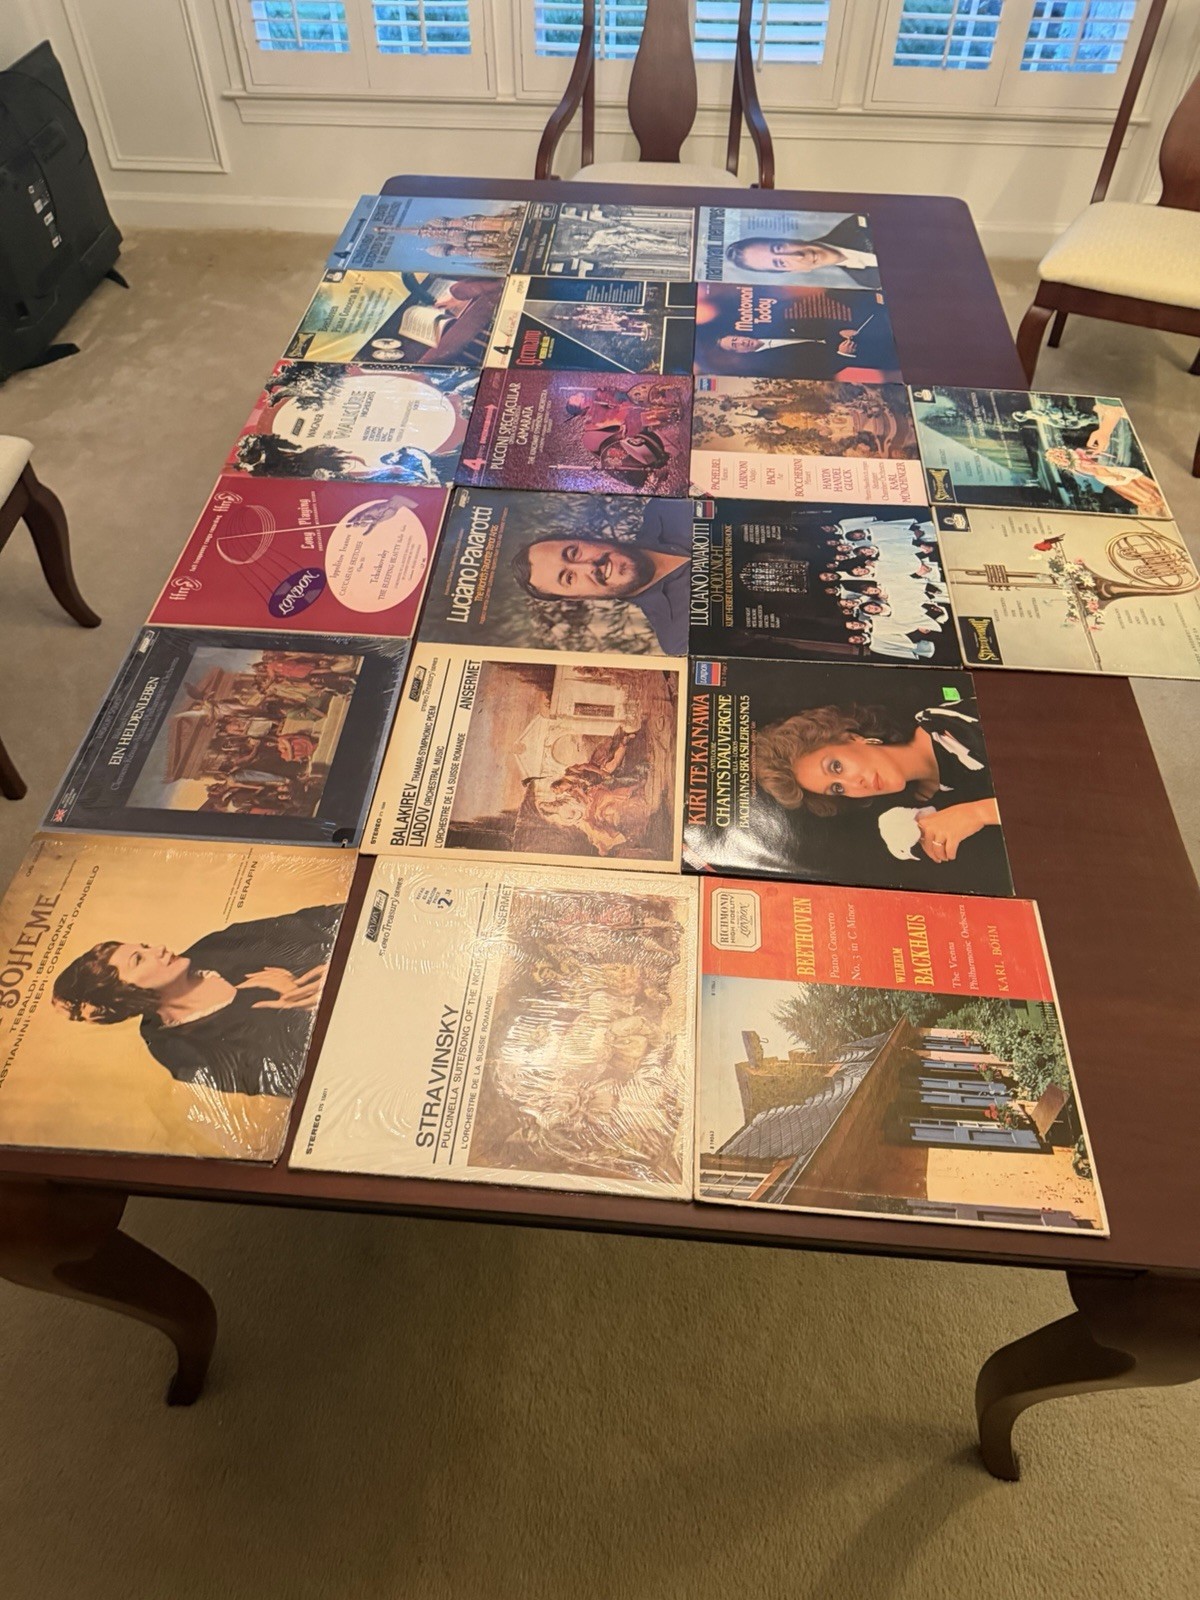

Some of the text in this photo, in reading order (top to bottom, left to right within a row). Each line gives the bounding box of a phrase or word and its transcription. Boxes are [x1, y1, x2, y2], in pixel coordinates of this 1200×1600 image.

[733, 286, 755, 331] Mantovani
[753, 297, 779, 324] Today
[491, 345, 512, 354] 4
[328, 390, 367, 439] WALKÜRE
[489, 382, 521, 469] PUCCINI SPECTACULAR
[515, 405, 534, 444] CAMARATA
[461, 456, 485, 470] 4
[738, 460, 748, 489] ALBINONI
[765, 467, 776, 485] BACH
[792, 458, 805, 496] BOCCHERINI
[820, 468, 832, 489] HAYDN
[842, 469, 854, 490] GLUCK
[887, 473, 899, 490] KARL
[298, 498, 313, 524] Playing
[459, 505, 493, 566] Pavarotti
[691, 522, 709, 572] PAVAROTTI
[710, 543, 724, 569] NIGHT
[276, 569, 320, 614] LONDON
[377, 589, 387, 600] THE
[445, 567, 479, 622] Luciano
[690, 573, 709, 625] LUCIANO
[711, 569, 723, 593] HOLY
[458, 659, 480, 710] ANSERMET
[699, 662, 708, 684] LONDON
[117, 675, 161, 744] HELDENLEBEN
[107, 746, 128, 765] EIN
[389, 782, 418, 846] BALAKIREV
[425, 705, 437, 721] POEM
[688, 692, 710, 825] KIRI TE KANAWA
[715, 693, 733, 827] CHANTS D'AUVERGNE
[737, 713, 752, 827] BACHIANAS BRASILEIRAS
[408, 745, 445, 847] LIADOV ORCHESTRAL MUSIC
[433, 732, 466, 848] L'ORCHESTRE DE LA SUISSE ROMANDE
[369, 818, 382, 844] STEREO
[236, 860, 257, 908] SERAFIN
[381, 897, 400, 932] Treasury
[720, 893, 729, 943] RICHMOND
[738, 901, 750, 937] LONDON
[792, 896, 816, 976] BEETHOVEN
[845, 902, 856, 928] Minor
[847, 931, 857, 939] C
[0, 893, 60, 1009] BOHEME
[29, 979, 48, 1014] SIEPI
[47, 921, 75, 975] CORENA
[71, 865, 100, 918] D'ANGELO
[825, 911, 840, 978] Piano Concerto
[848, 942, 858, 951] in
[905, 913, 935, 986] BACKHAUS
[956, 903, 979, 990] Philharmonic Orchestra
[9, 913, 69, 1033] TEBALDI BERGONZI
[850, 963, 861, 980] No.
[892, 946, 906, 983] WILHELM
[945, 941, 962, 988] The Vienna
[993, 959, 1010, 992] KARL
[414, 1003, 460, 1148] STRAVINSKY
[439, 988, 478, 1148] PULCINELLA SUITE/SONG OF THE
[460, 994, 494, 1149] L'ORCHESTRE DE LA SUISSE ROMANDE
[304, 1113, 322, 1155] STEREO
